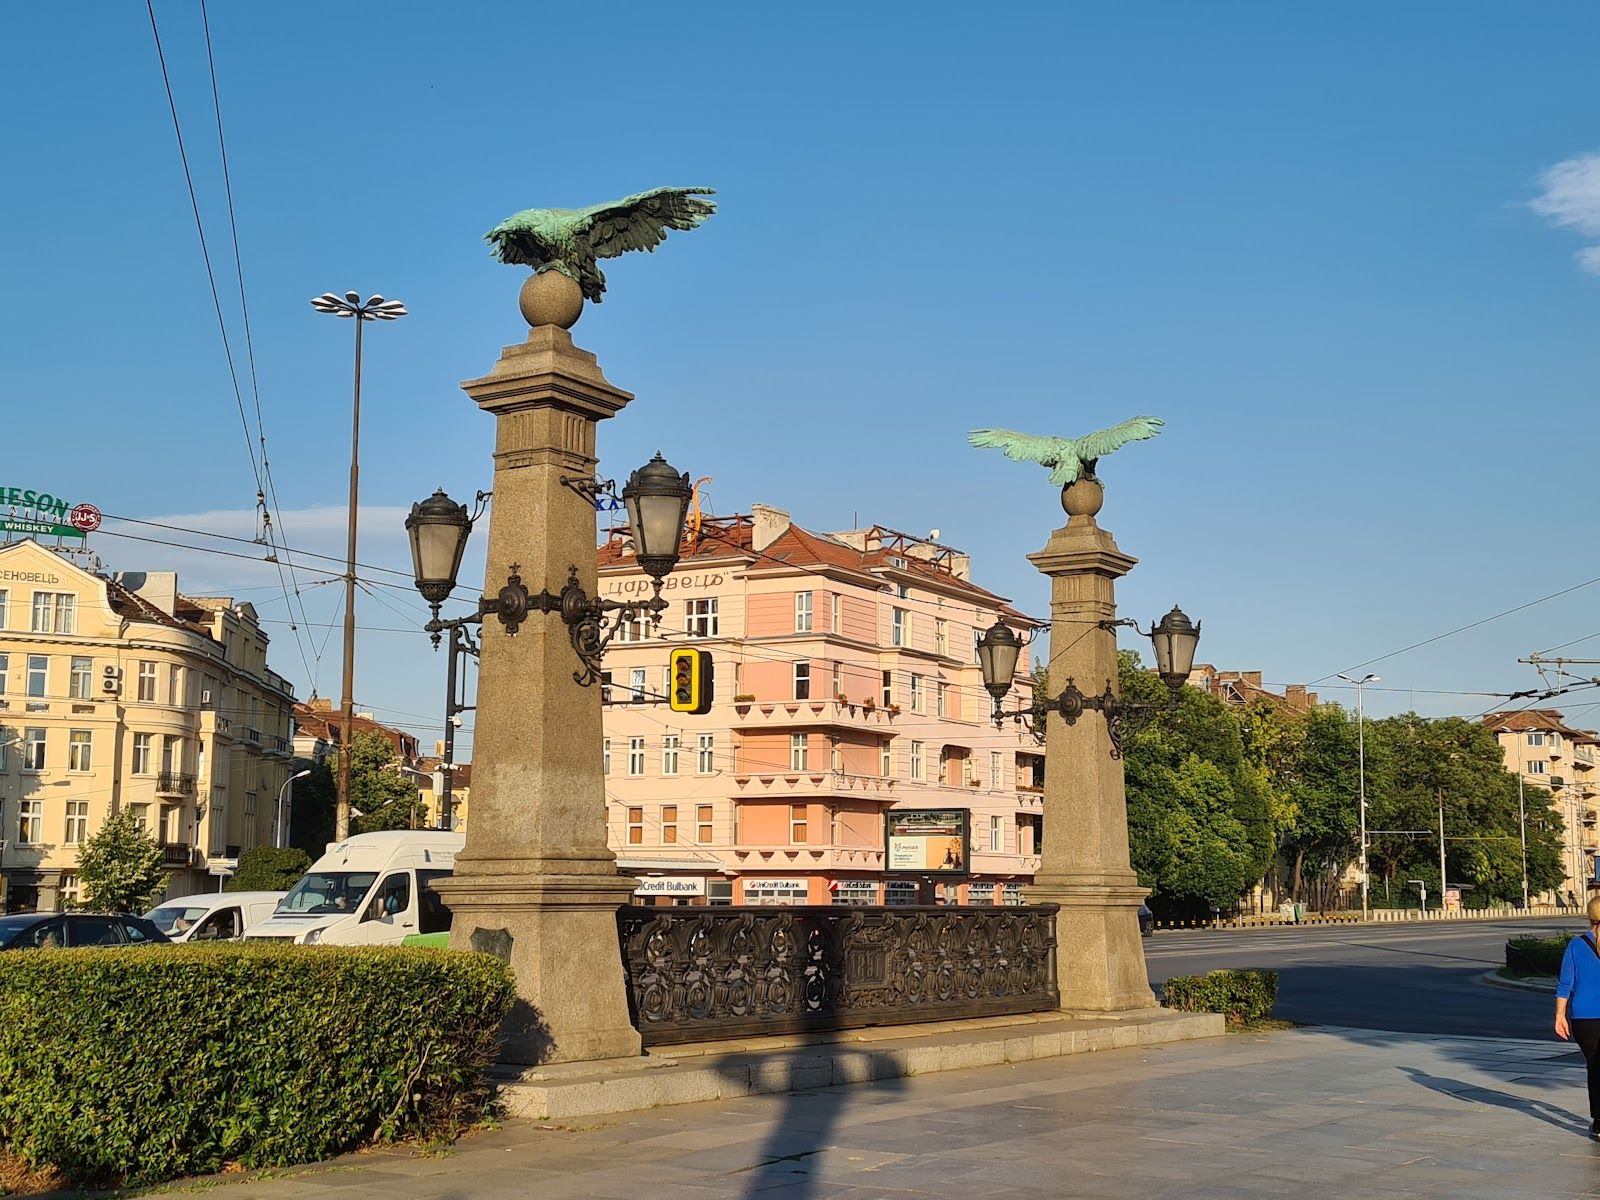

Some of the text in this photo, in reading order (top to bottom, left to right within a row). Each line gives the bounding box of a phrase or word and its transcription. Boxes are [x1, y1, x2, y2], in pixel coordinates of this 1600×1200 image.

[4, 522, 54, 534] WHISKEY
[666, 881, 698, 891] Bulbank
[756, 881, 801, 889] UniCredit Bulbank
